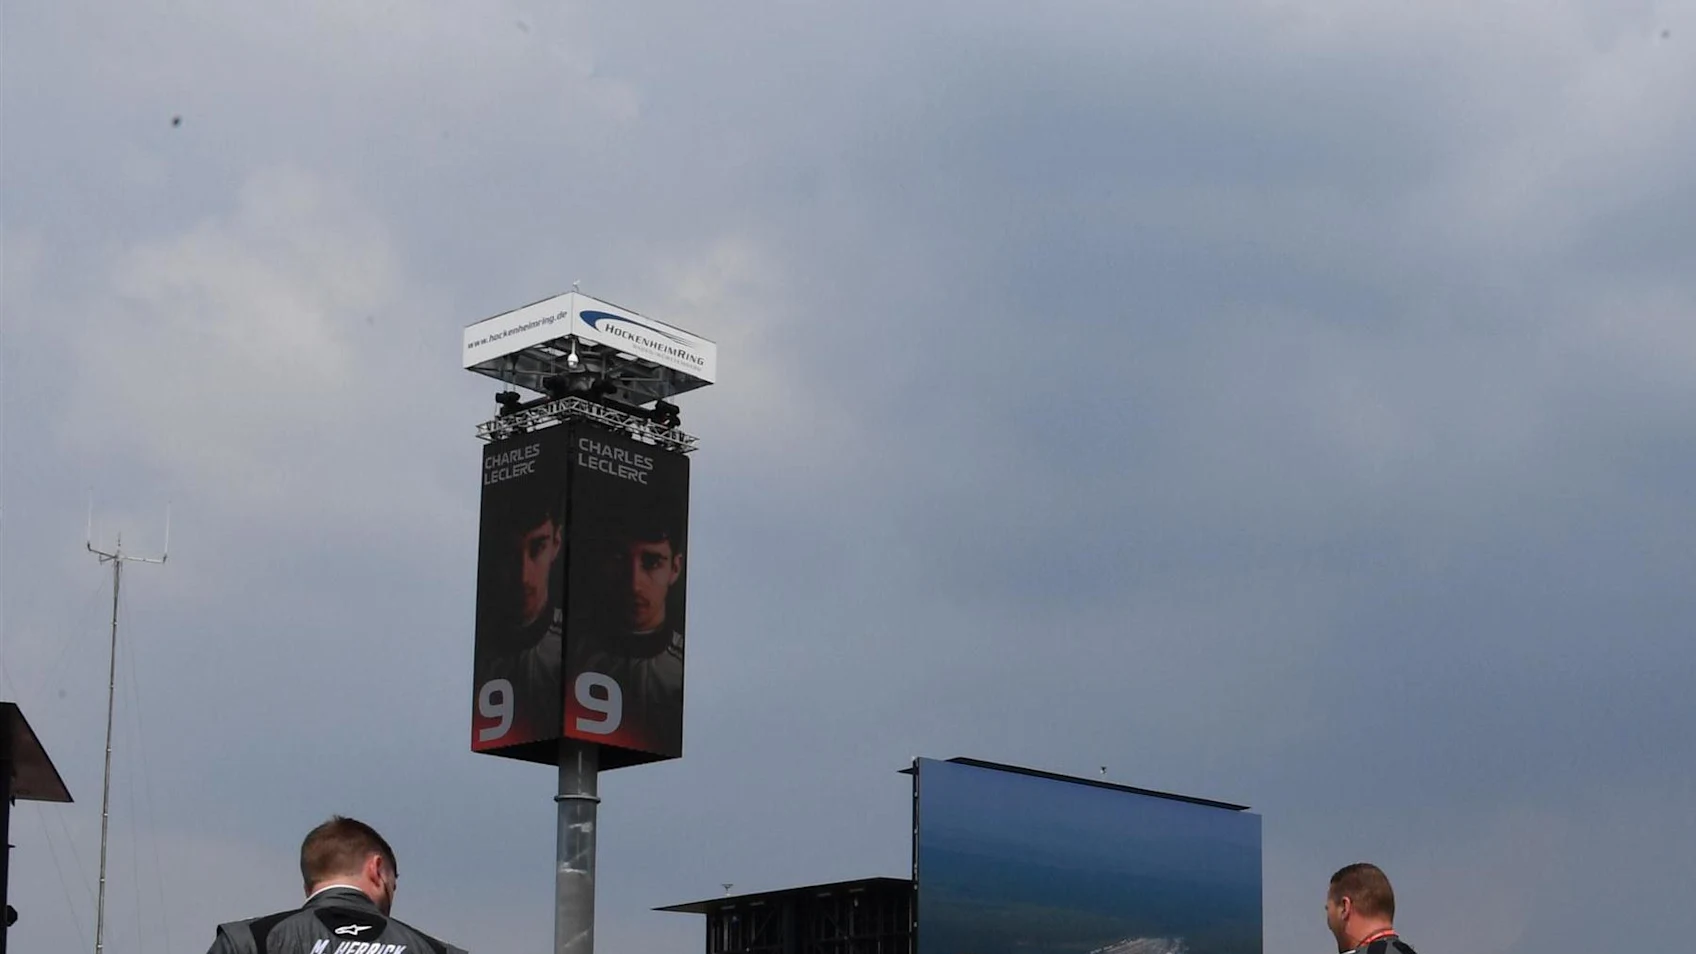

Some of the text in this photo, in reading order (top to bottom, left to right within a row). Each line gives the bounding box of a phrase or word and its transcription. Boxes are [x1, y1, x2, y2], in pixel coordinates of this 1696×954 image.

[467, 310, 568, 349] www.hockenheimring.de
[485, 443, 540, 470] CHARLES
[578, 437, 654, 471] CHARLES
[578, 452, 648, 485] LECLERC
[484, 459, 536, 486] LECLERC
[478, 678, 514, 742] 9
[574, 671, 623, 735] 9
